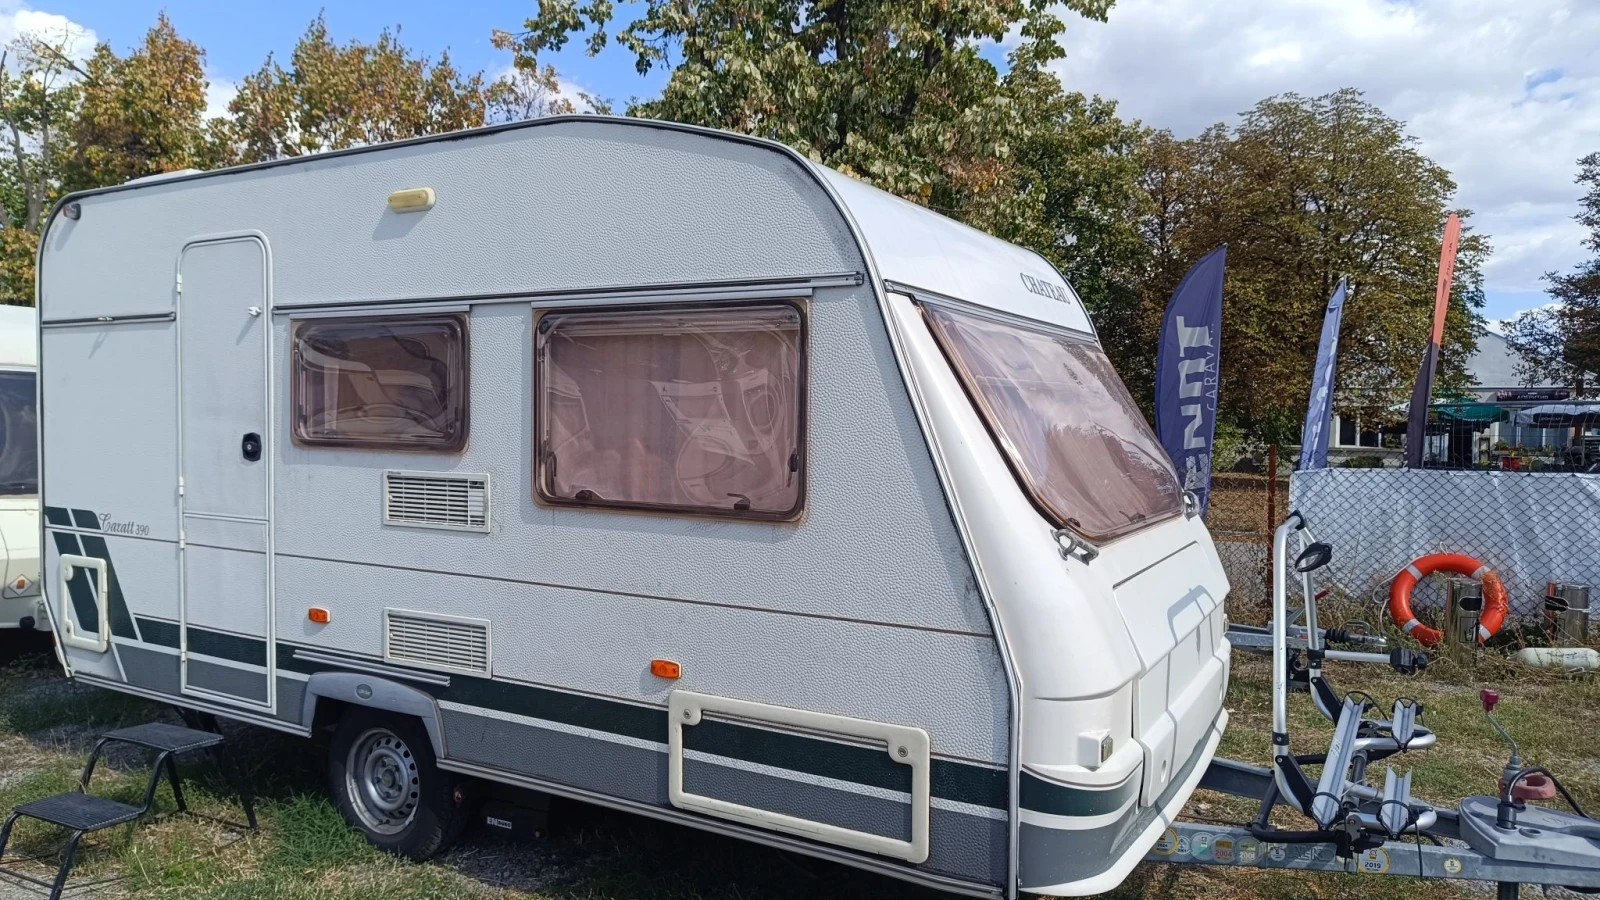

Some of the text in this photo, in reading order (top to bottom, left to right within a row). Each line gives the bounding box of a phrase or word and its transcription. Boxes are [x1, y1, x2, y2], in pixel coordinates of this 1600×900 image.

[1019, 272, 1071, 305] CHATEAU
[1203, 322, 1217, 412] CARAVA
[1175, 316, 1210, 492] ENDT
[98, 513, 150, 536] Caratt 390
[1364, 861, 1381, 869] 2019
